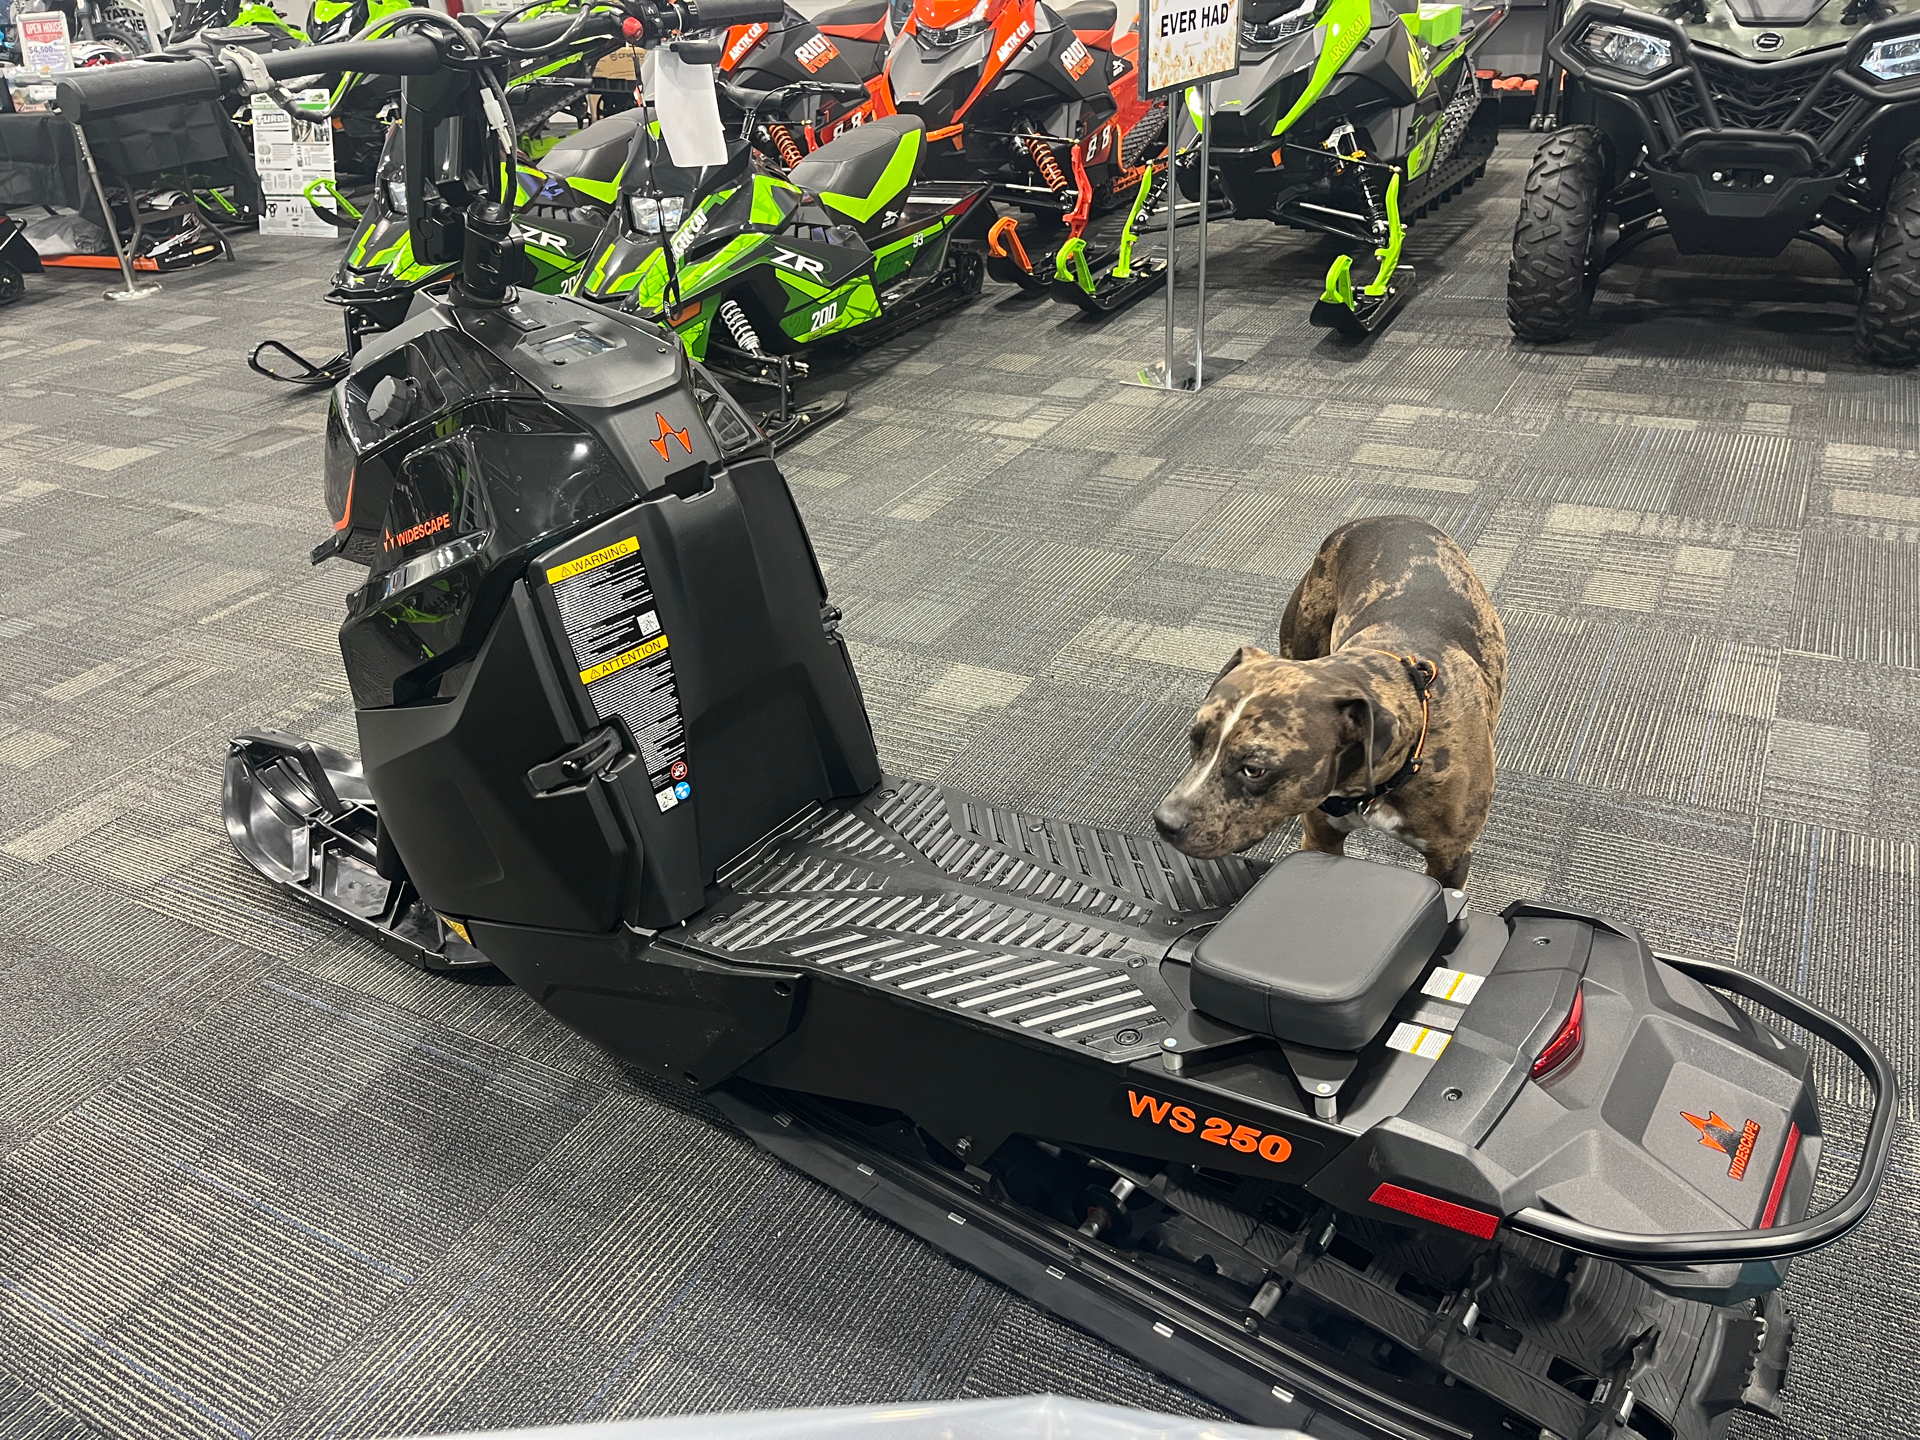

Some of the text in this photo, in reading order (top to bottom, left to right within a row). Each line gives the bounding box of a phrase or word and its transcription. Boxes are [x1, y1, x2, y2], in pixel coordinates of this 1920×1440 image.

[25, 21, 62, 35] OPEN HOUSE
[1161, 3, 1229, 38] EVER HAD
[728, 22, 763, 61] ARCTIC CAT
[795, 33, 832, 64] RIOT
[996, 20, 1031, 62] ARCTIC CAT
[1060, 38, 1089, 70] RIOT
[1328, 14, 1366, 65] ARCTIC CAT
[690, 208, 708, 234] CAT
[519, 223, 567, 257] ZR
[912, 232, 924, 249] 93
[770, 245, 824, 284] ZR
[810, 301, 838, 333] 200
[396, 513, 451, 548] WIDESCAPE
[571, 543, 628, 573] WARNING
[602, 640, 661, 675] ATTENTION
[1127, 1090, 1293, 1163] WS 250
[1728, 1119, 1759, 1180] WIDESCAPE
